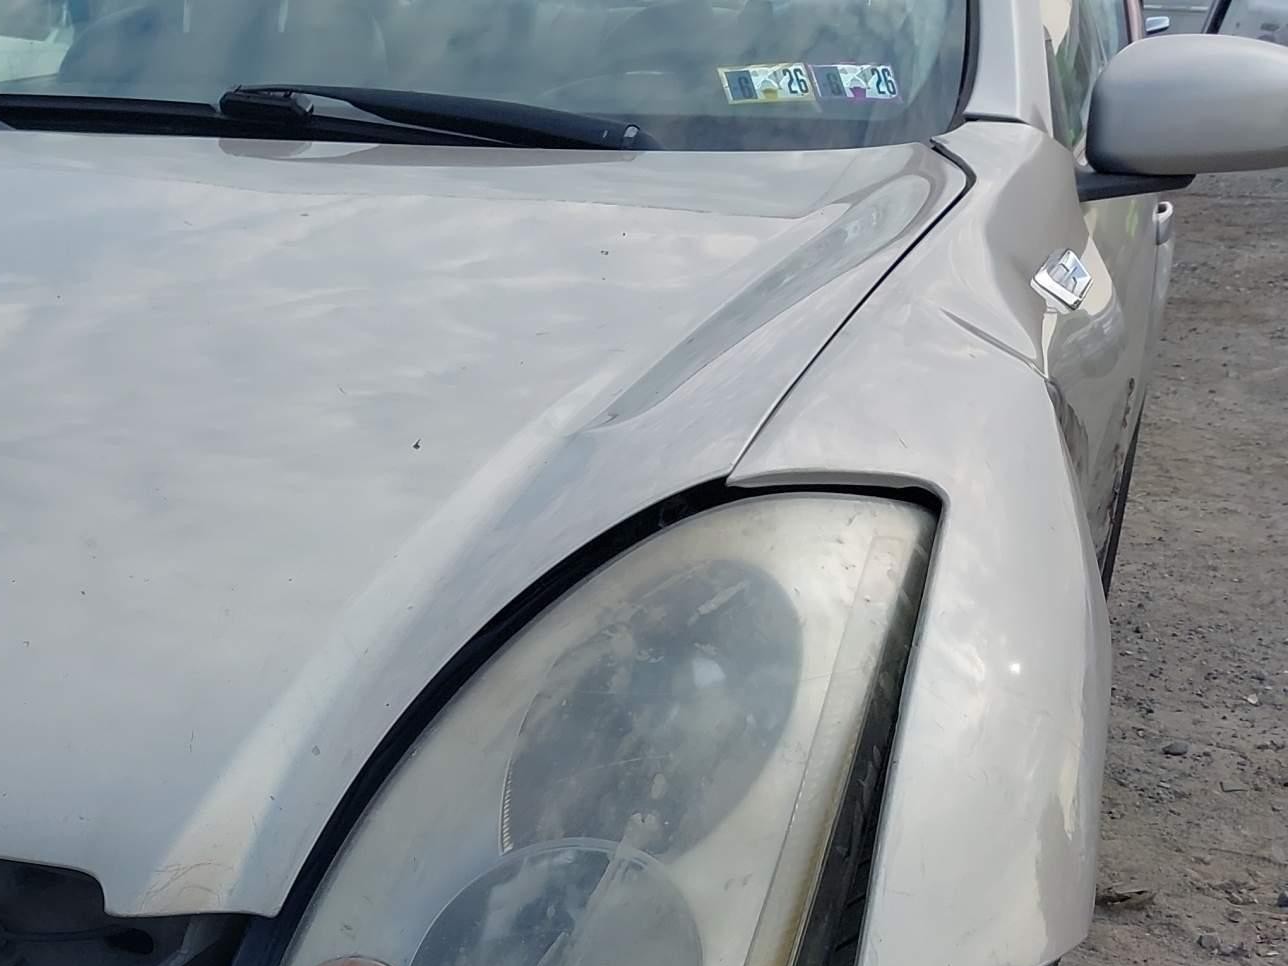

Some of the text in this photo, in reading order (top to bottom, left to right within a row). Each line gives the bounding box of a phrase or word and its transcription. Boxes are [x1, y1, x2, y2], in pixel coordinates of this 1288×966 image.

[738, 67, 809, 99] 6 26
[871, 67, 897, 96] 26
